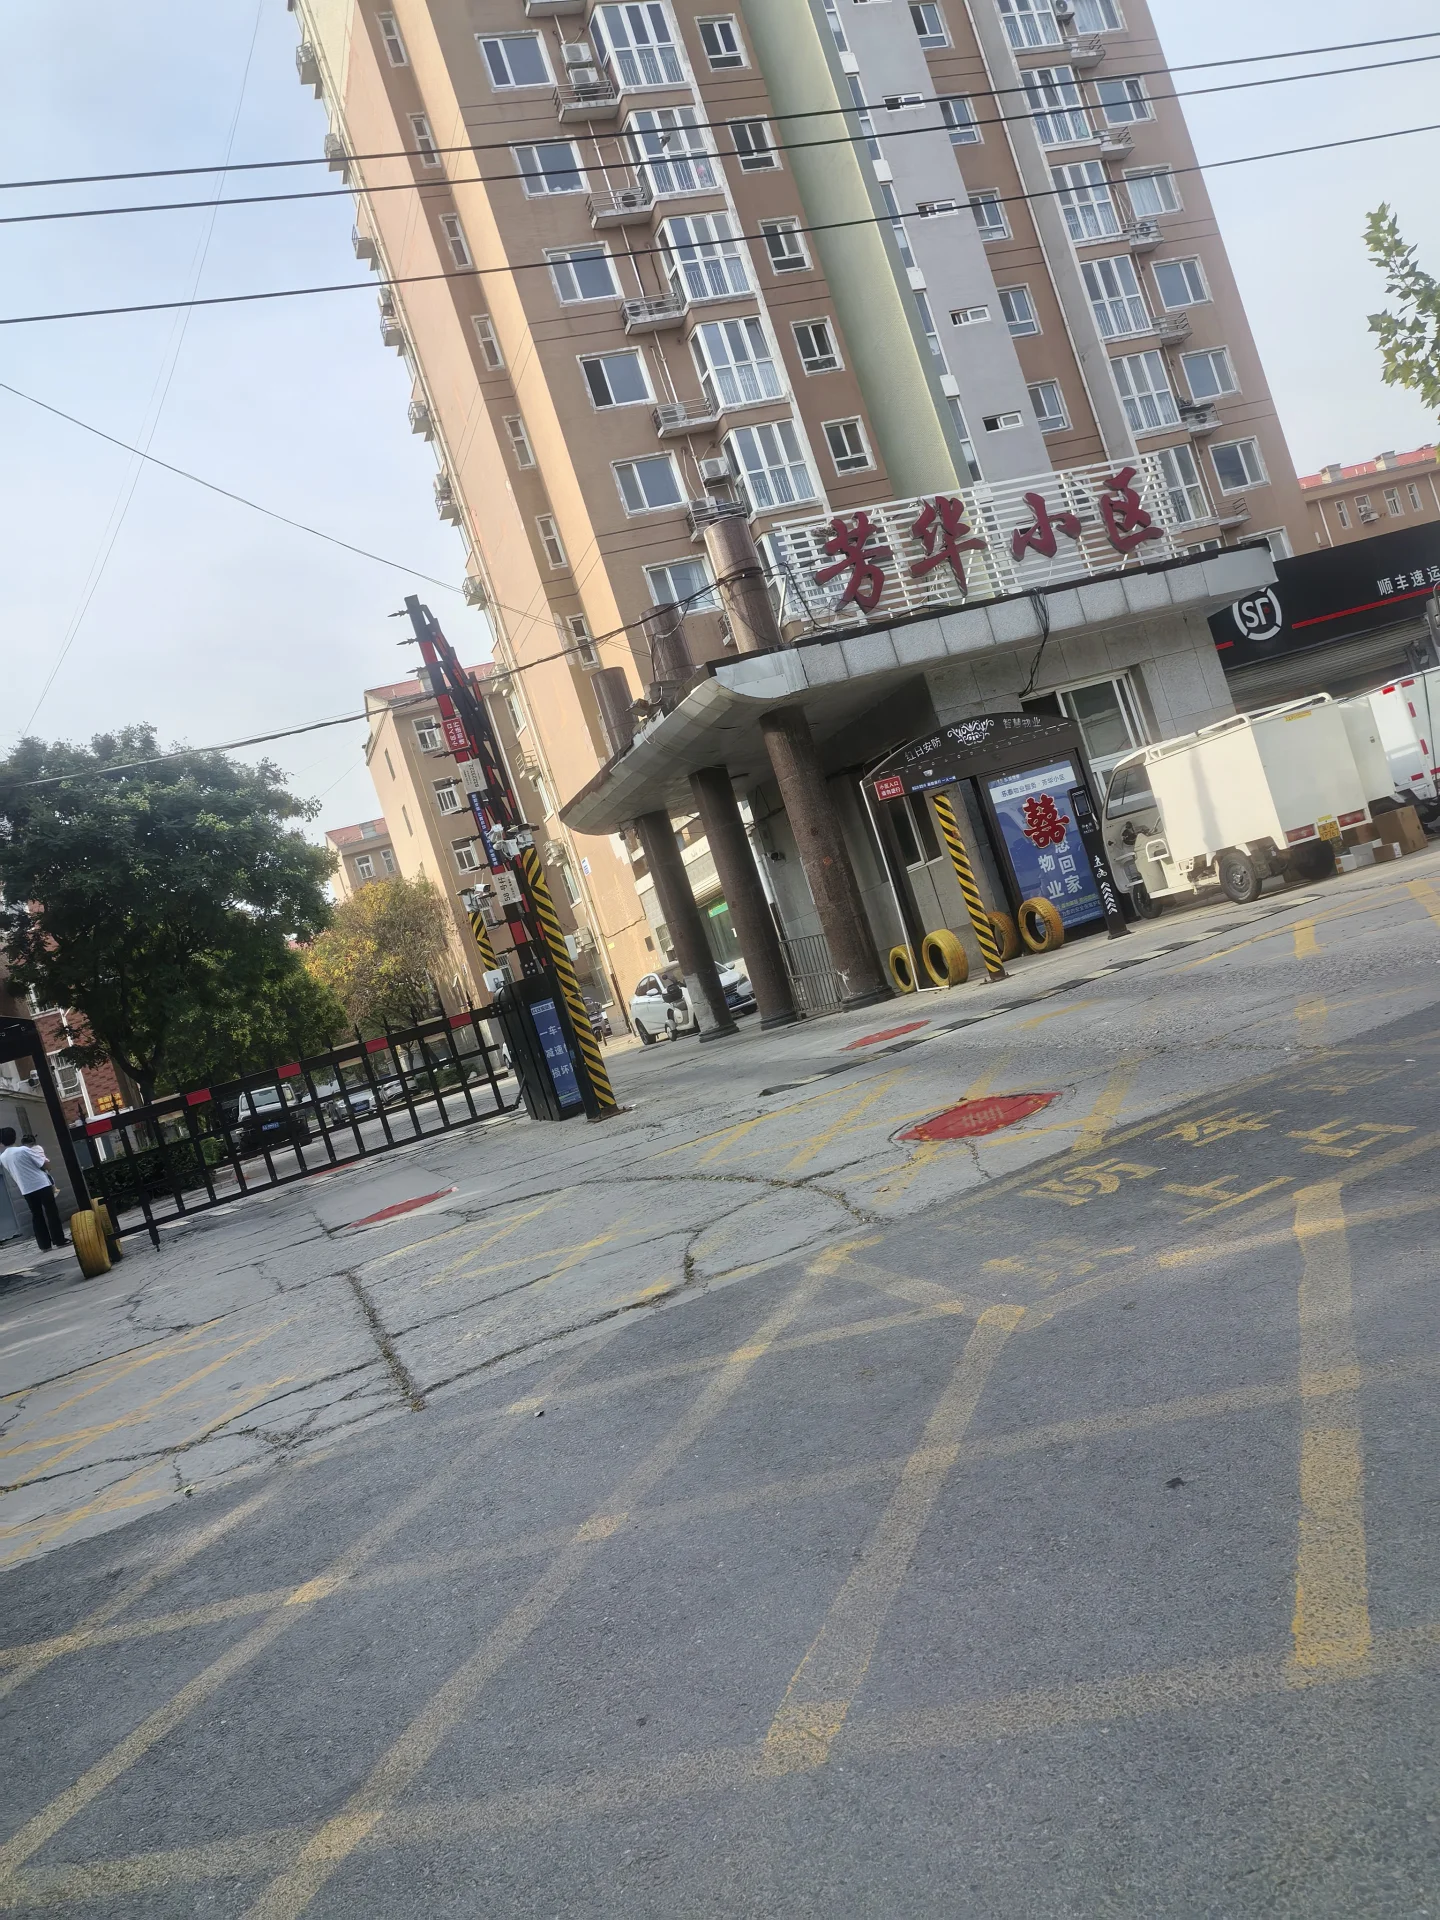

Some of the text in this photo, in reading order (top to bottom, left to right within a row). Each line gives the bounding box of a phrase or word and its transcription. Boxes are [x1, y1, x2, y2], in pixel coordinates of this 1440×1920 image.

[814, 466, 1164, 613] 芳华小区
[1377, 565, 1440, 596] 顺丰速运
[1002, 716, 1042, 729] 智慧物业
[904, 736, 942, 762] 红日安防
[879, 780, 899, 790] 小区入口
[1038, 854, 1064, 900] 物业
